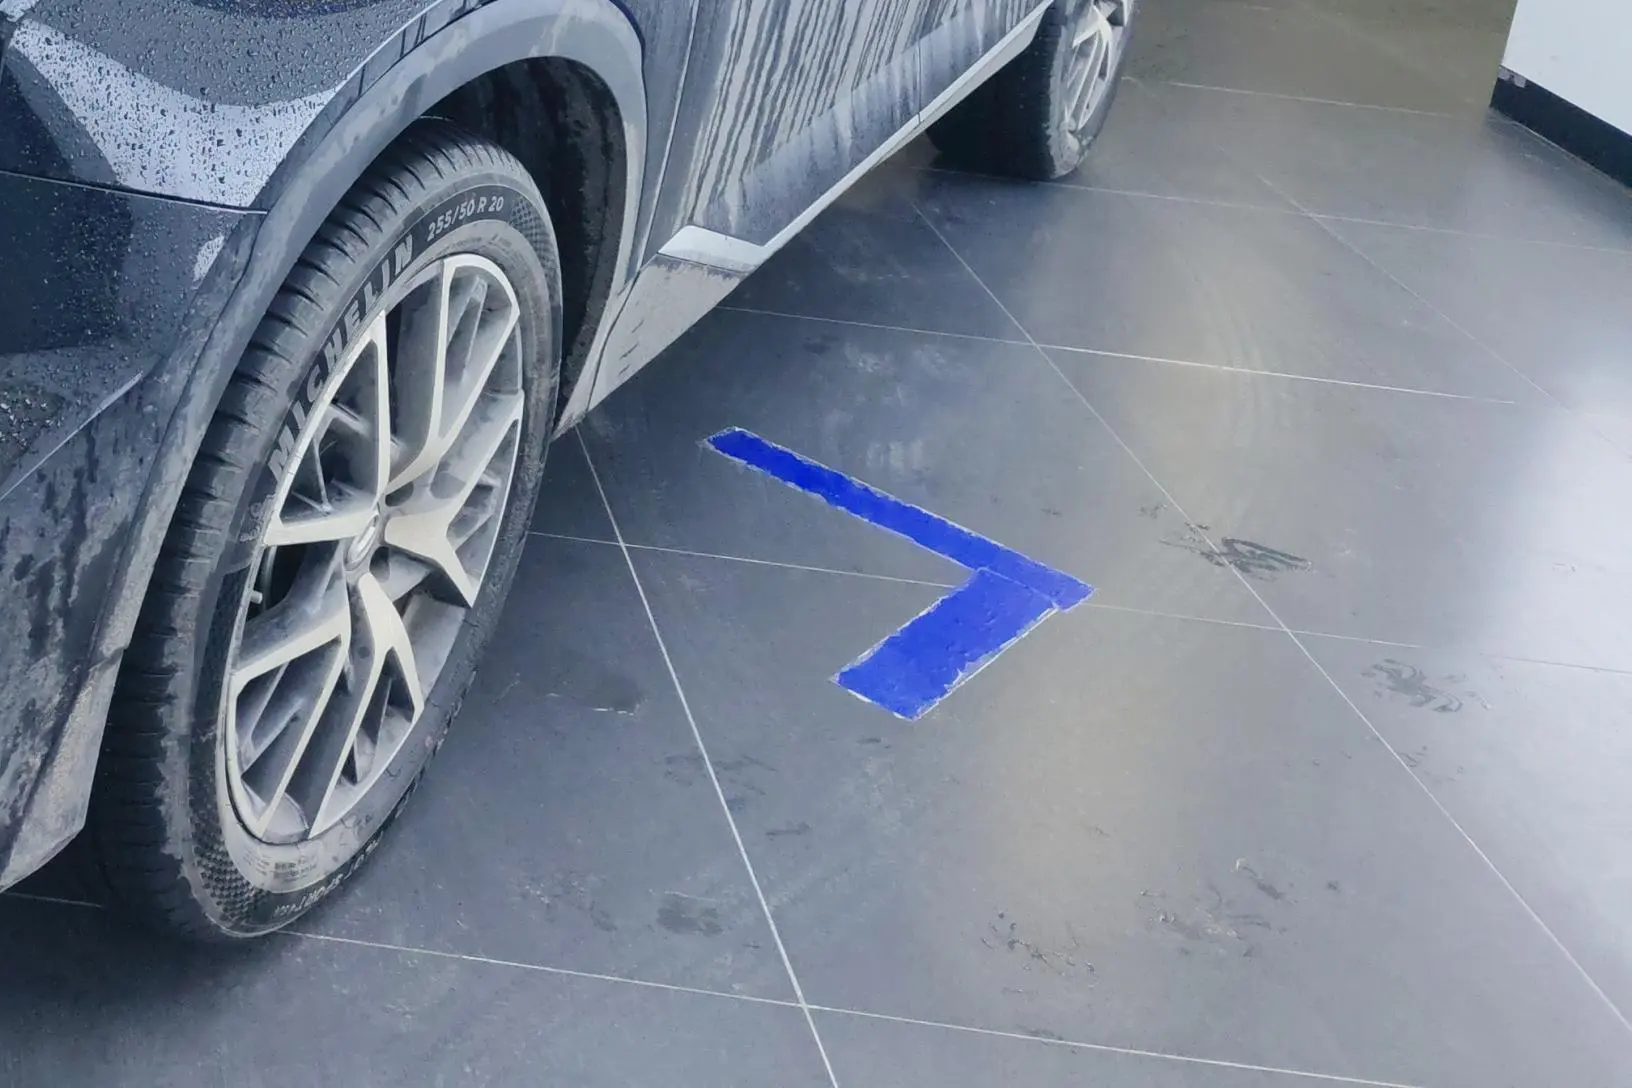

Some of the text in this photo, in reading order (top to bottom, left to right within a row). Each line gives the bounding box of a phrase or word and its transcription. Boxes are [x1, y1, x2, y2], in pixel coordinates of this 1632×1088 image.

[428, 196, 504, 242] 255/50 R 20
[270, 233, 414, 484] MICHELIN
